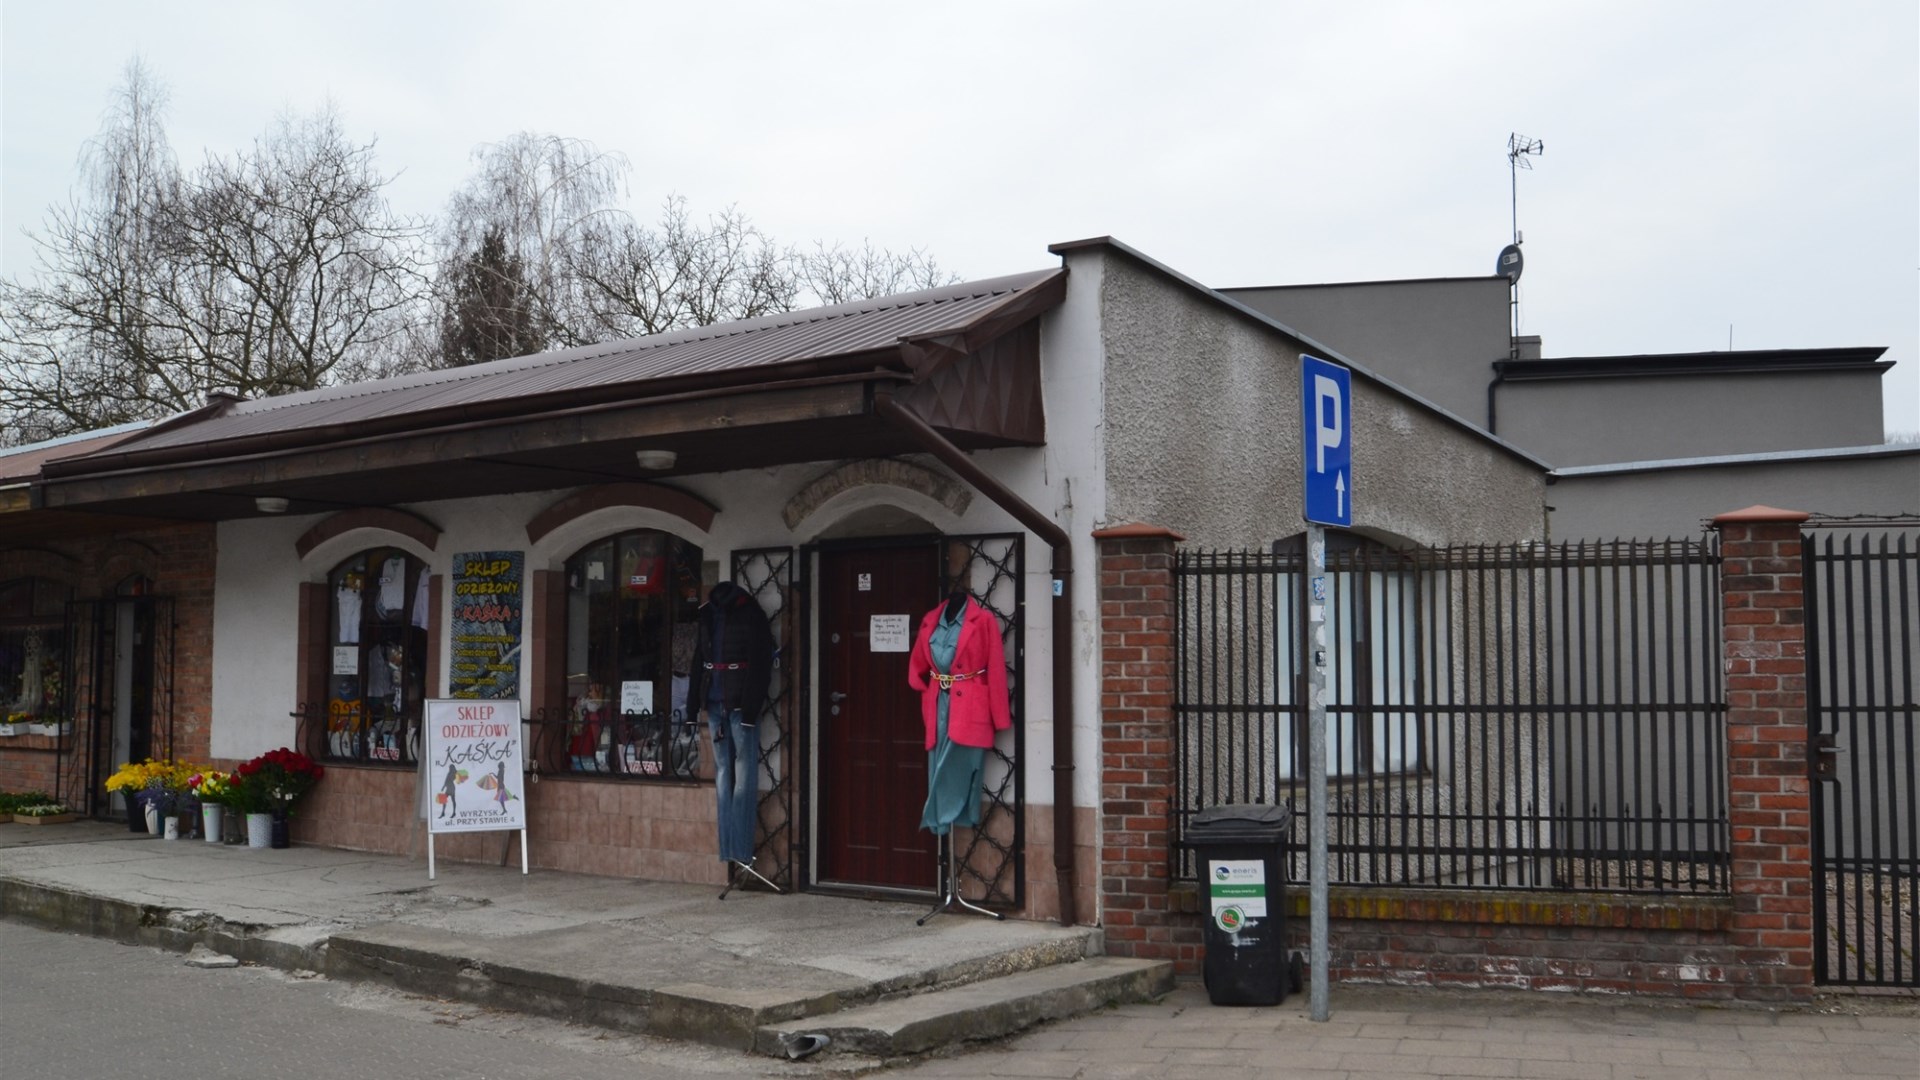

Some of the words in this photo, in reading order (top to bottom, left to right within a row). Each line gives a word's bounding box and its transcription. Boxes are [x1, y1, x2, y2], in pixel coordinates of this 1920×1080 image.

[1315, 374, 1342, 474] P
[465, 560, 511, 577] SKLEP
[456, 581, 518, 595] ODZIEŻOWY
[463, 602, 511, 622] KAŚKA
[458, 706, 495, 721] SKLEP
[442, 722, 510, 738] ODZIEŻOWY
[457, 817, 478, 825] PRZY
[479, 816, 508, 825] STAWIE
[460, 809, 498, 818] WYRZYSK
